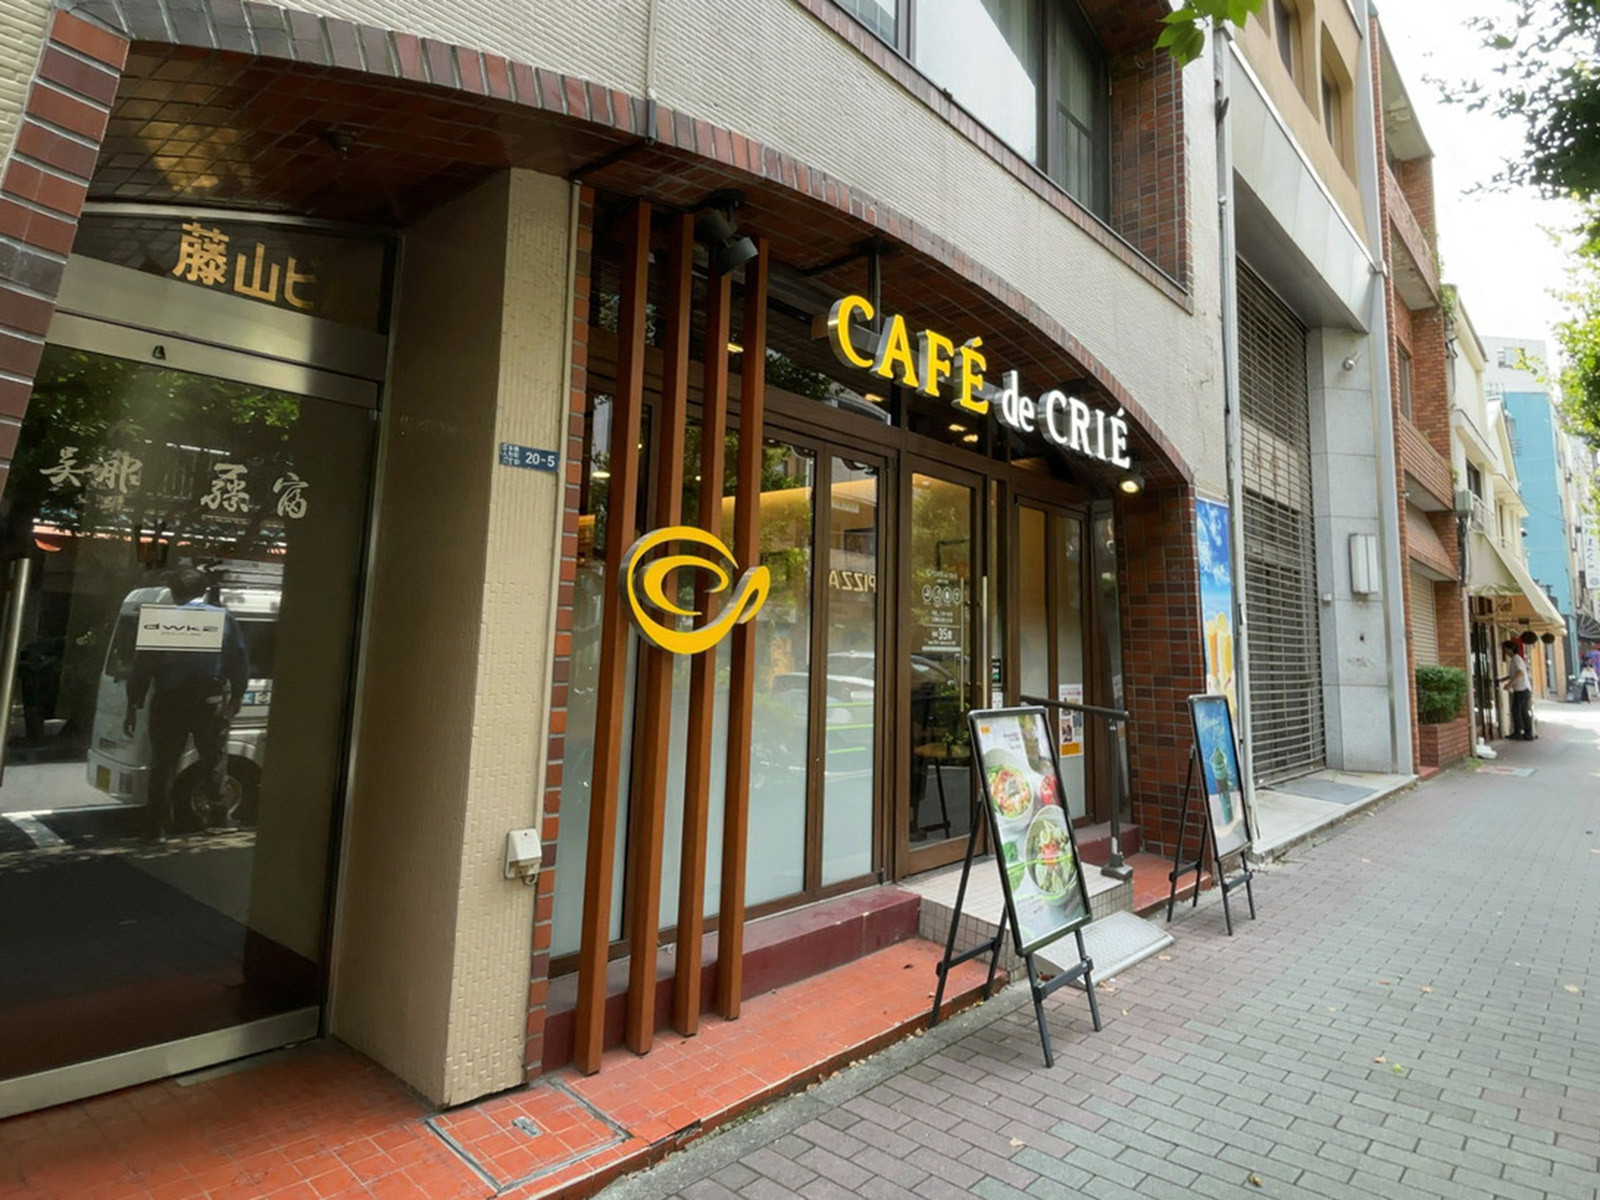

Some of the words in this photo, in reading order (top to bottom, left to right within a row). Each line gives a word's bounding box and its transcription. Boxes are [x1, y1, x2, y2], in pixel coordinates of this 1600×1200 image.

[831, 295, 988, 415] CAFÉ
[997, 370, 1034, 432] de
[1040, 389, 1130, 469] CRIÉ
[525, 451, 556, 468] 20-5
